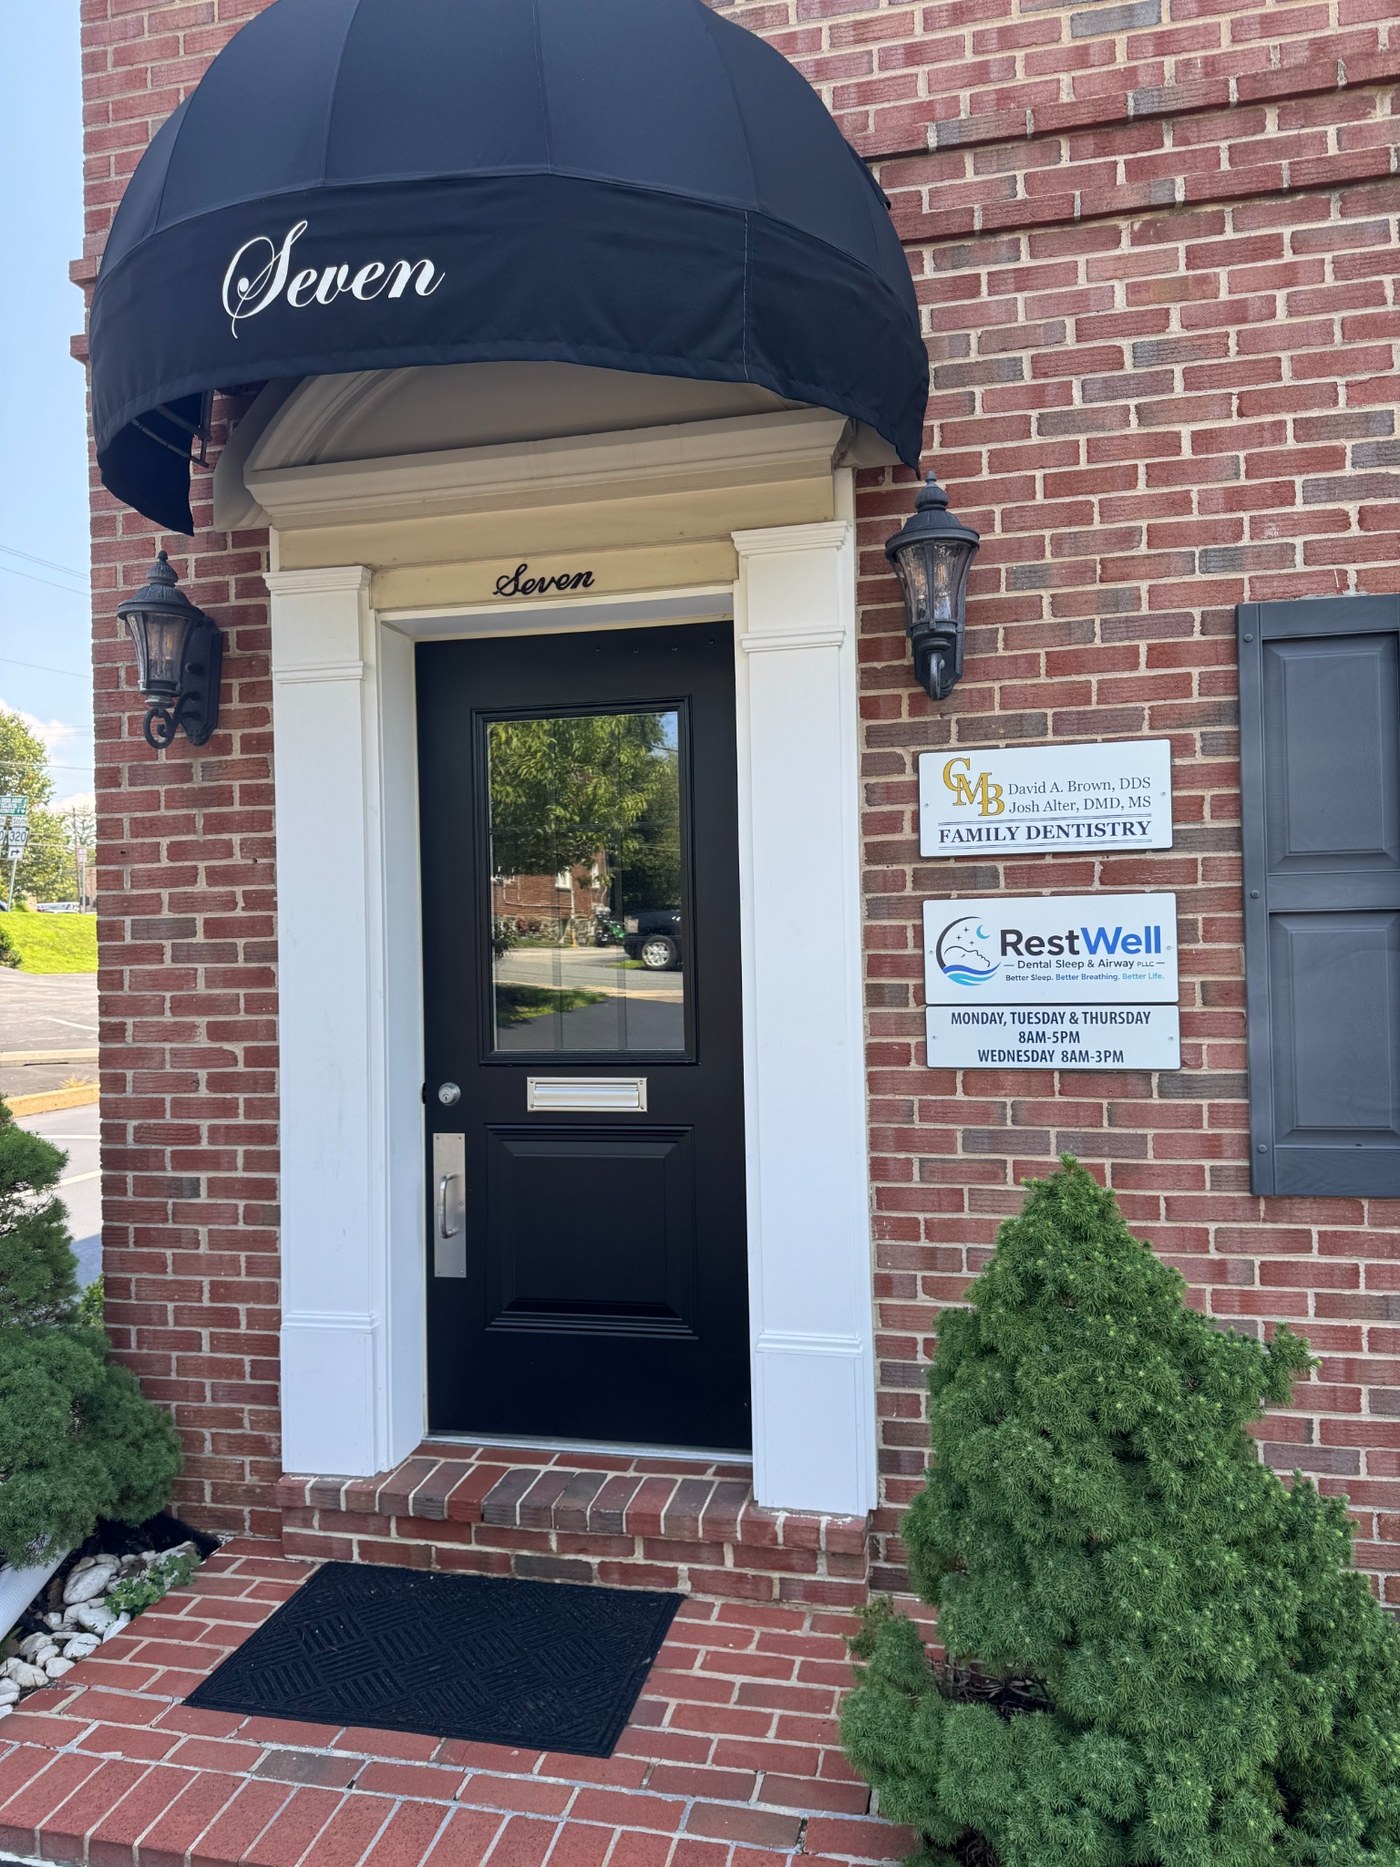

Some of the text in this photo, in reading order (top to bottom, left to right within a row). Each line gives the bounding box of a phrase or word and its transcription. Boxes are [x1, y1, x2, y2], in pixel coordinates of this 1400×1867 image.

[222, 219, 446, 339] Seven
[492, 563, 595, 597] Seven
[1008, 777, 1151, 795] David A. Brown, DDS
[1008, 795, 1151, 814] Josh Alter, DMD, MS
[9, 831, 26, 842] 320
[938, 821, 1152, 843] FAMILY DENTISTRY
[1000, 925, 1162, 957] RestWell
[1017, 960, 1051, 969] Dental
[1055, 959, 1085, 970] Sleep
[1087, 960, 1095, 968] &
[1097, 958, 1134, 969] Airway
[1005, 974, 1029, 982] Better
[1030, 974, 1054, 983] Sleep.
[1055, 973, 1079, 981] Better
[1081, 973, 1121, 982] Breathing.
[1148, 972, 1165, 980] Life.
[951, 1011, 1151, 1027] MONDAY, TUESDAY & THURSDAY
[1018, 1030, 1081, 1044] 8AM-5PM
[977, 1049, 1124, 1063] WEDNESDAY 8AM-3PM
